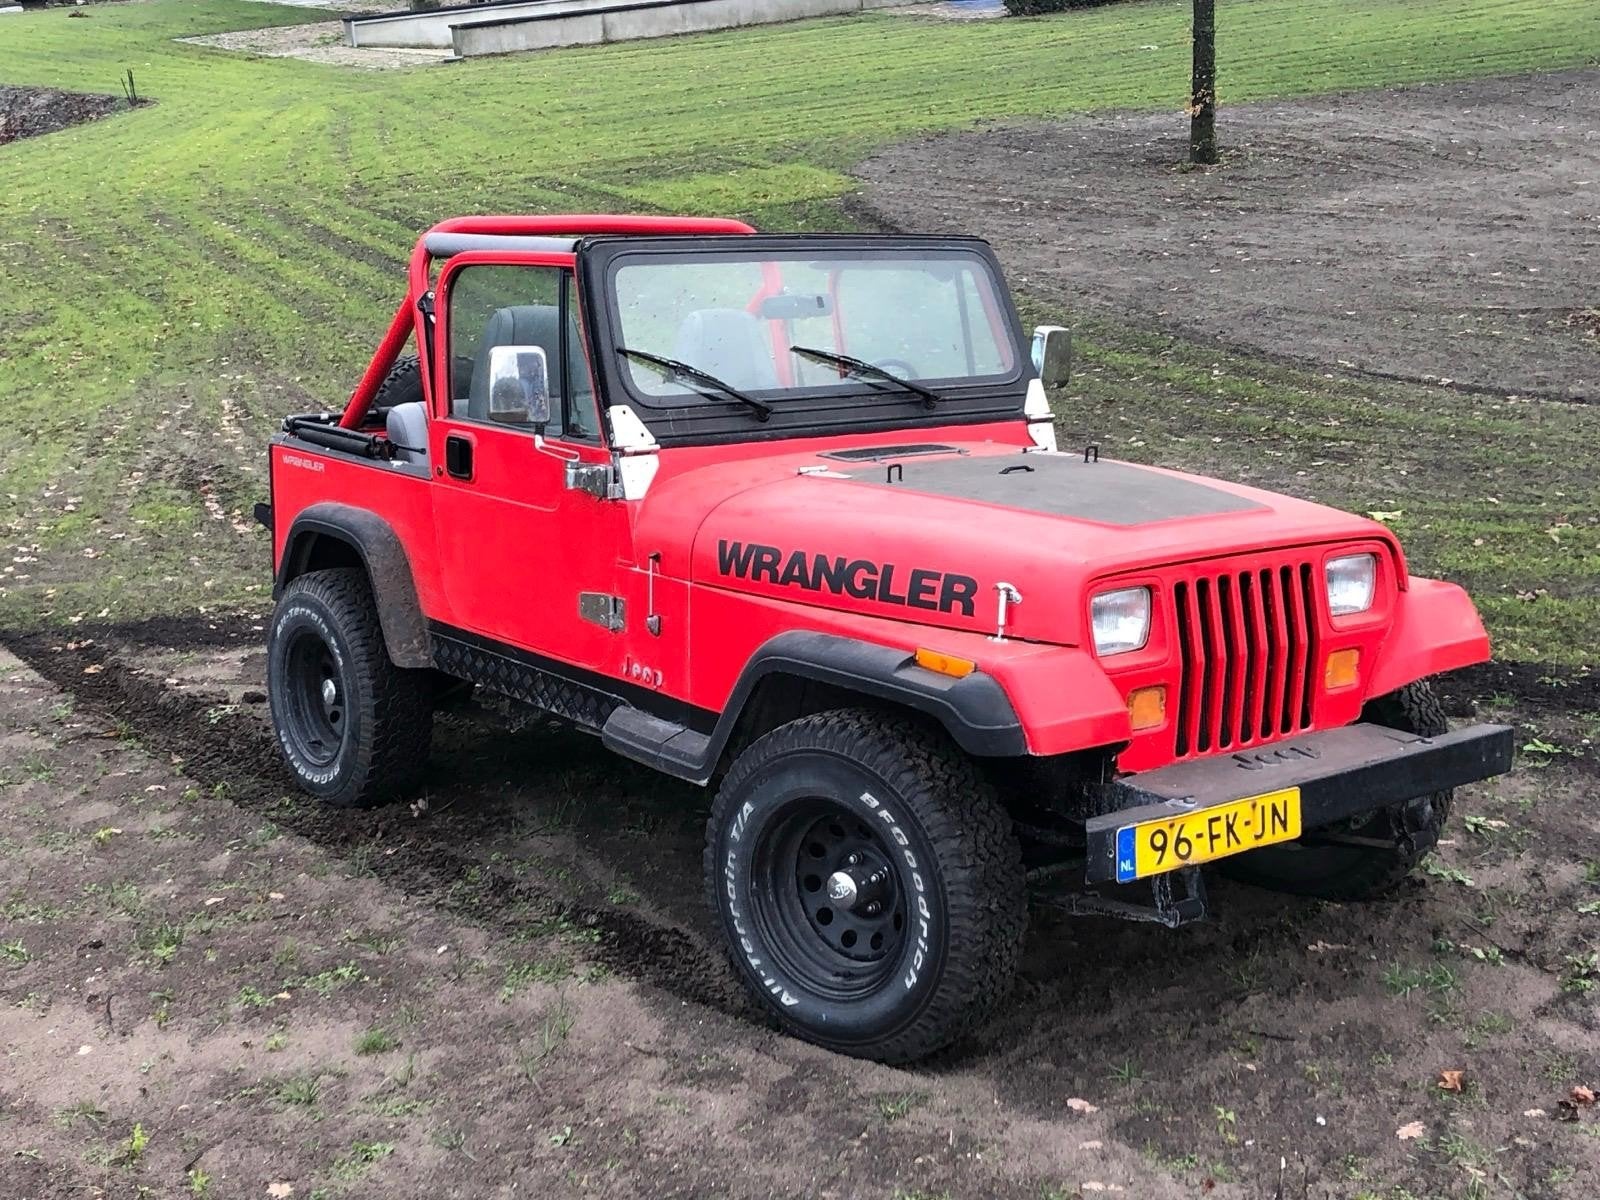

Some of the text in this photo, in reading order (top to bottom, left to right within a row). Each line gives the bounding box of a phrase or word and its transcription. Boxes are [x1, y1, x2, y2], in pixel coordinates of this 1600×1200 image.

[282, 454, 326, 473] WRANGLER
[718, 539, 979, 617] WRANGLER
[622, 655, 663, 690] Jeep
[729, 800, 755, 843] T/A
[1149, 799, 1289, 866] 96-FK-JN
[1120, 859, 1134, 873] NL
